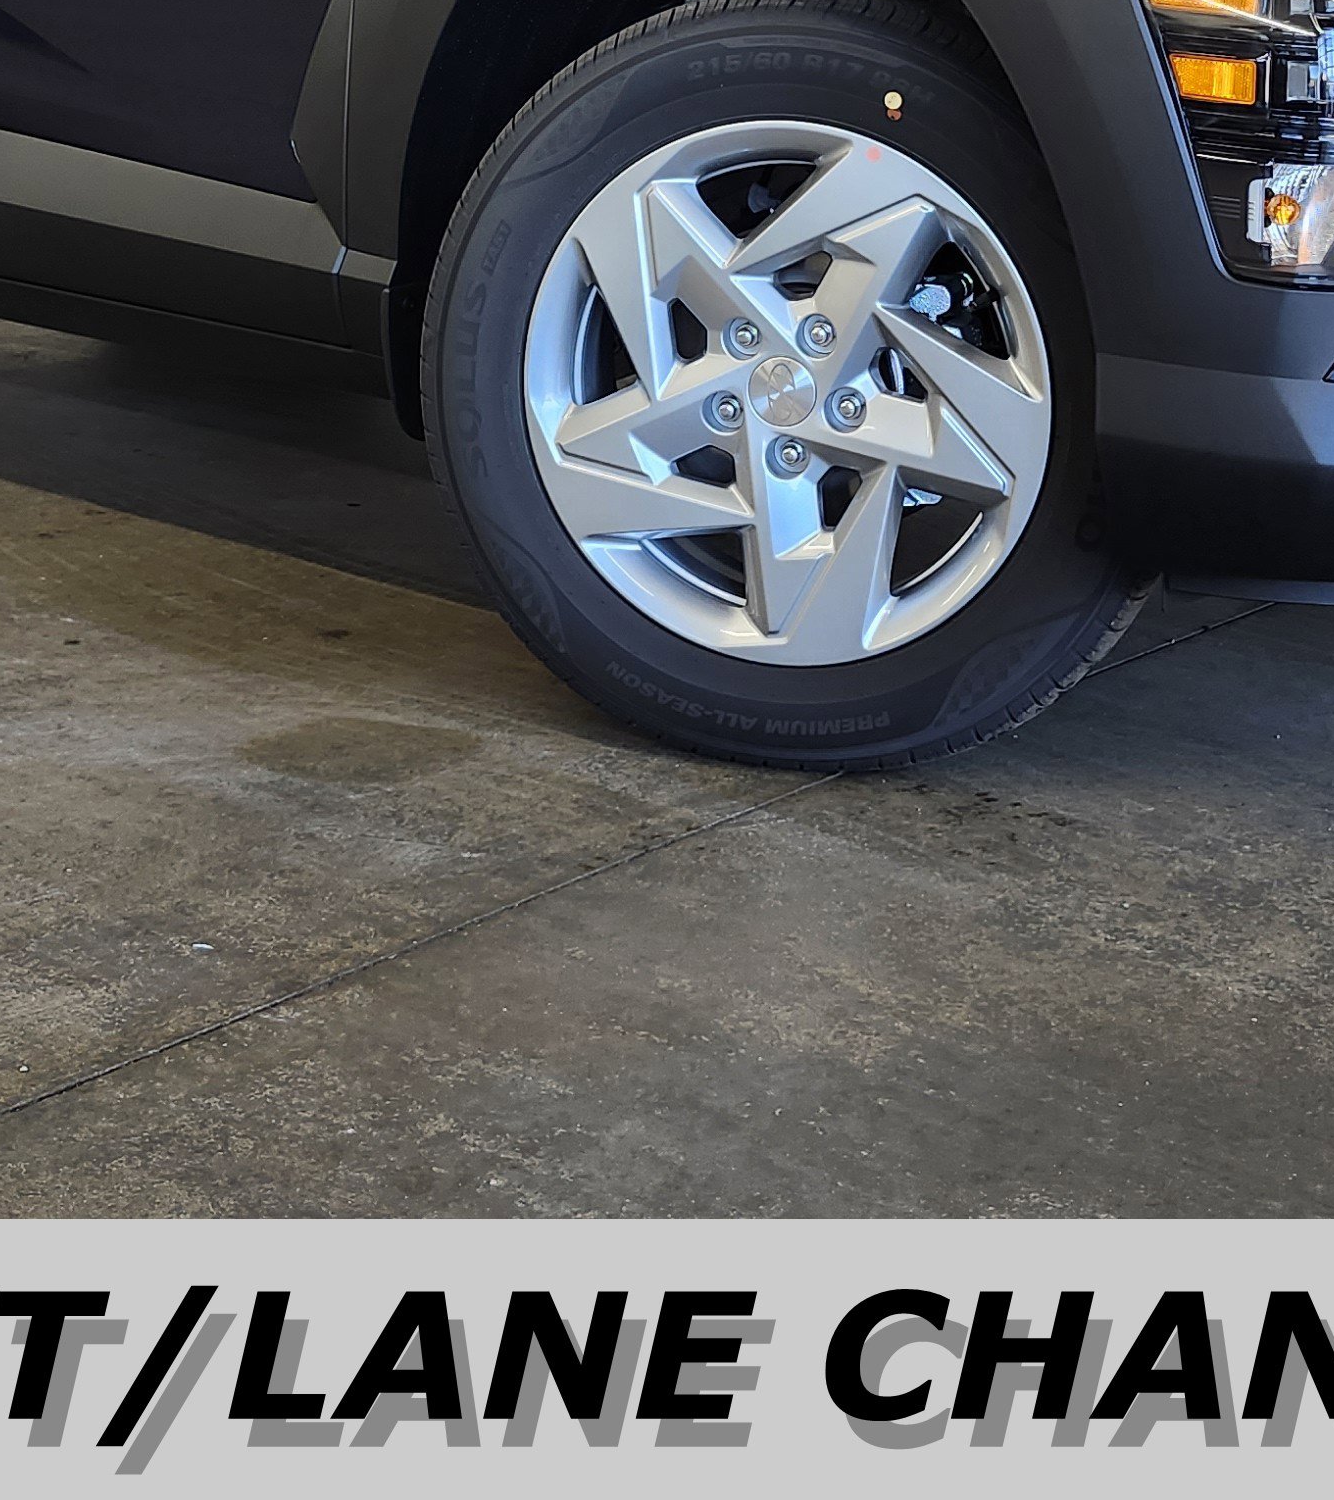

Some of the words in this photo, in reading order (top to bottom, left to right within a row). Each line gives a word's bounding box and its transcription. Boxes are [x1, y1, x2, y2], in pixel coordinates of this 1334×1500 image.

[686, 52, 792, 81] 215/60
[455, 282, 489, 478] SOLUS
[603, 659, 759, 732] ALL-SEASON
[763, 710, 891, 737] PREMIUM
